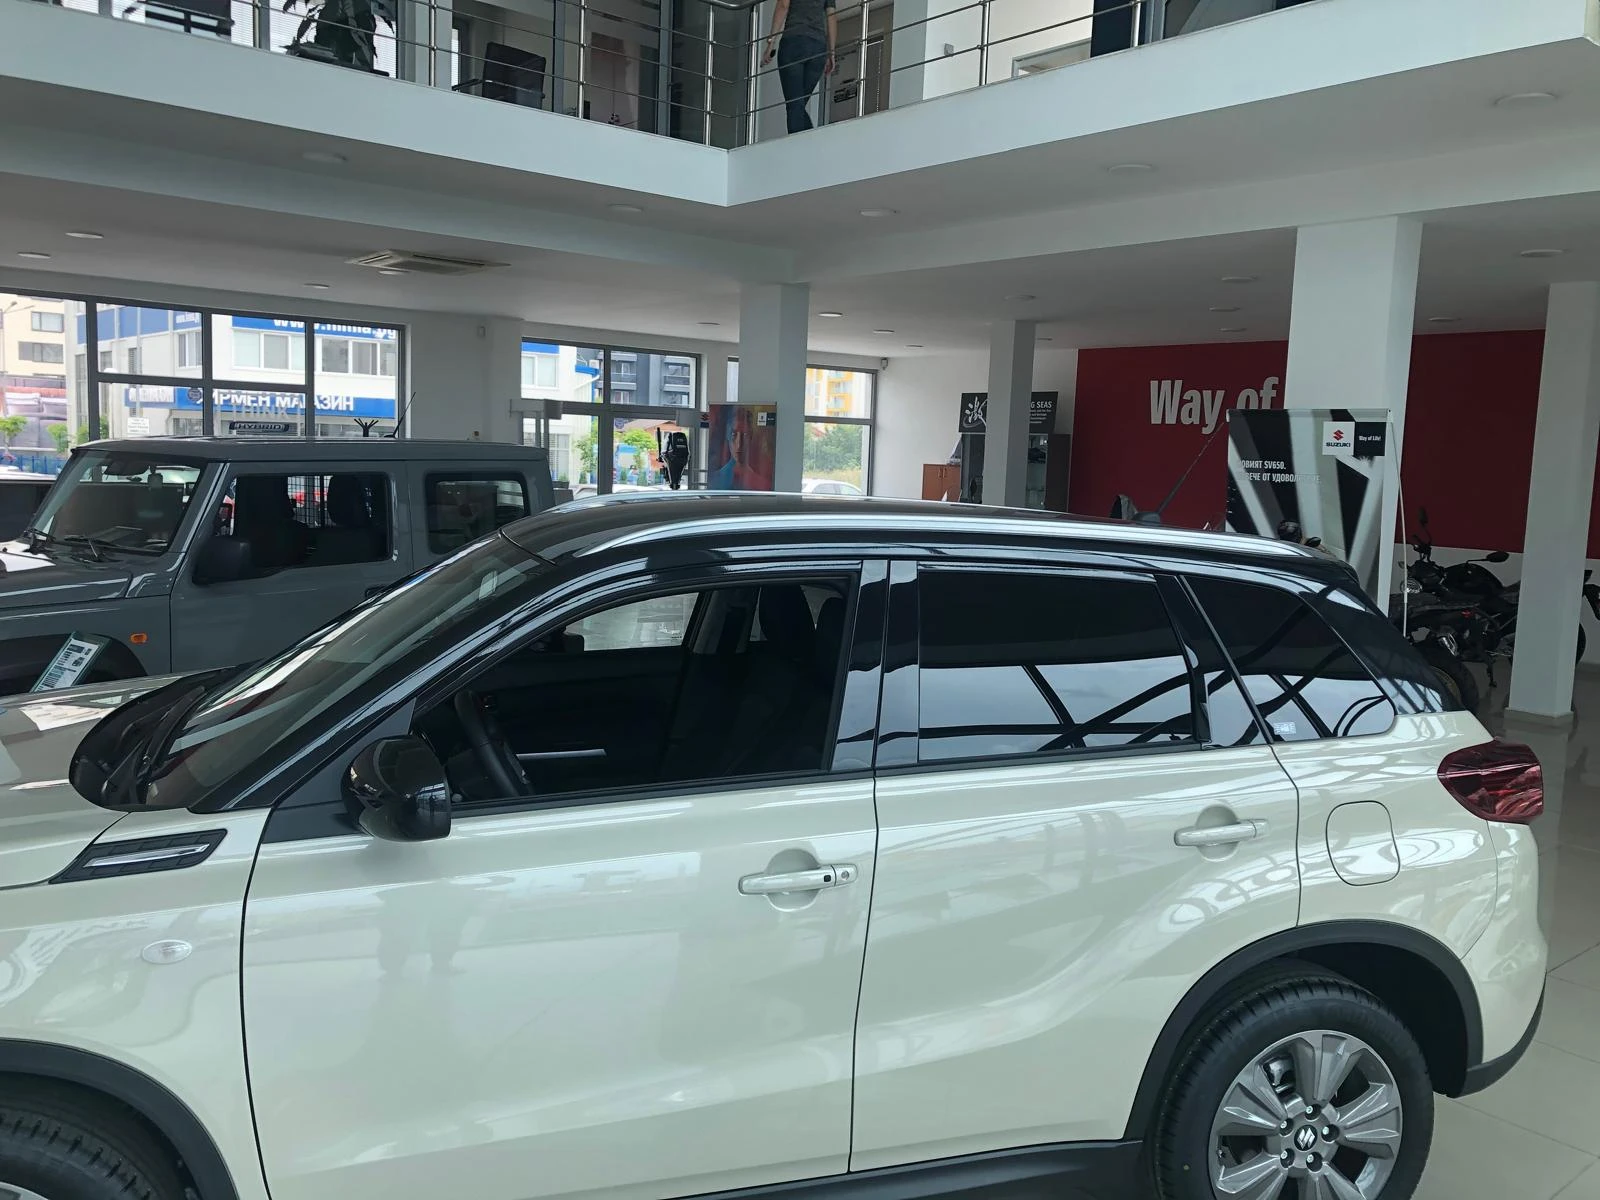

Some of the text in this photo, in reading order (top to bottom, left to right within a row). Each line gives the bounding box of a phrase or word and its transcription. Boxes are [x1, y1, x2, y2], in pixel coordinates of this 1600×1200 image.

[275, 393, 354, 411] МААЗИН
[1150, 376, 1279, 435] Way of
[1239, 460, 1287, 470] ОВИЯТ SV650.
[1262, 473, 1271, 482] ОТ
